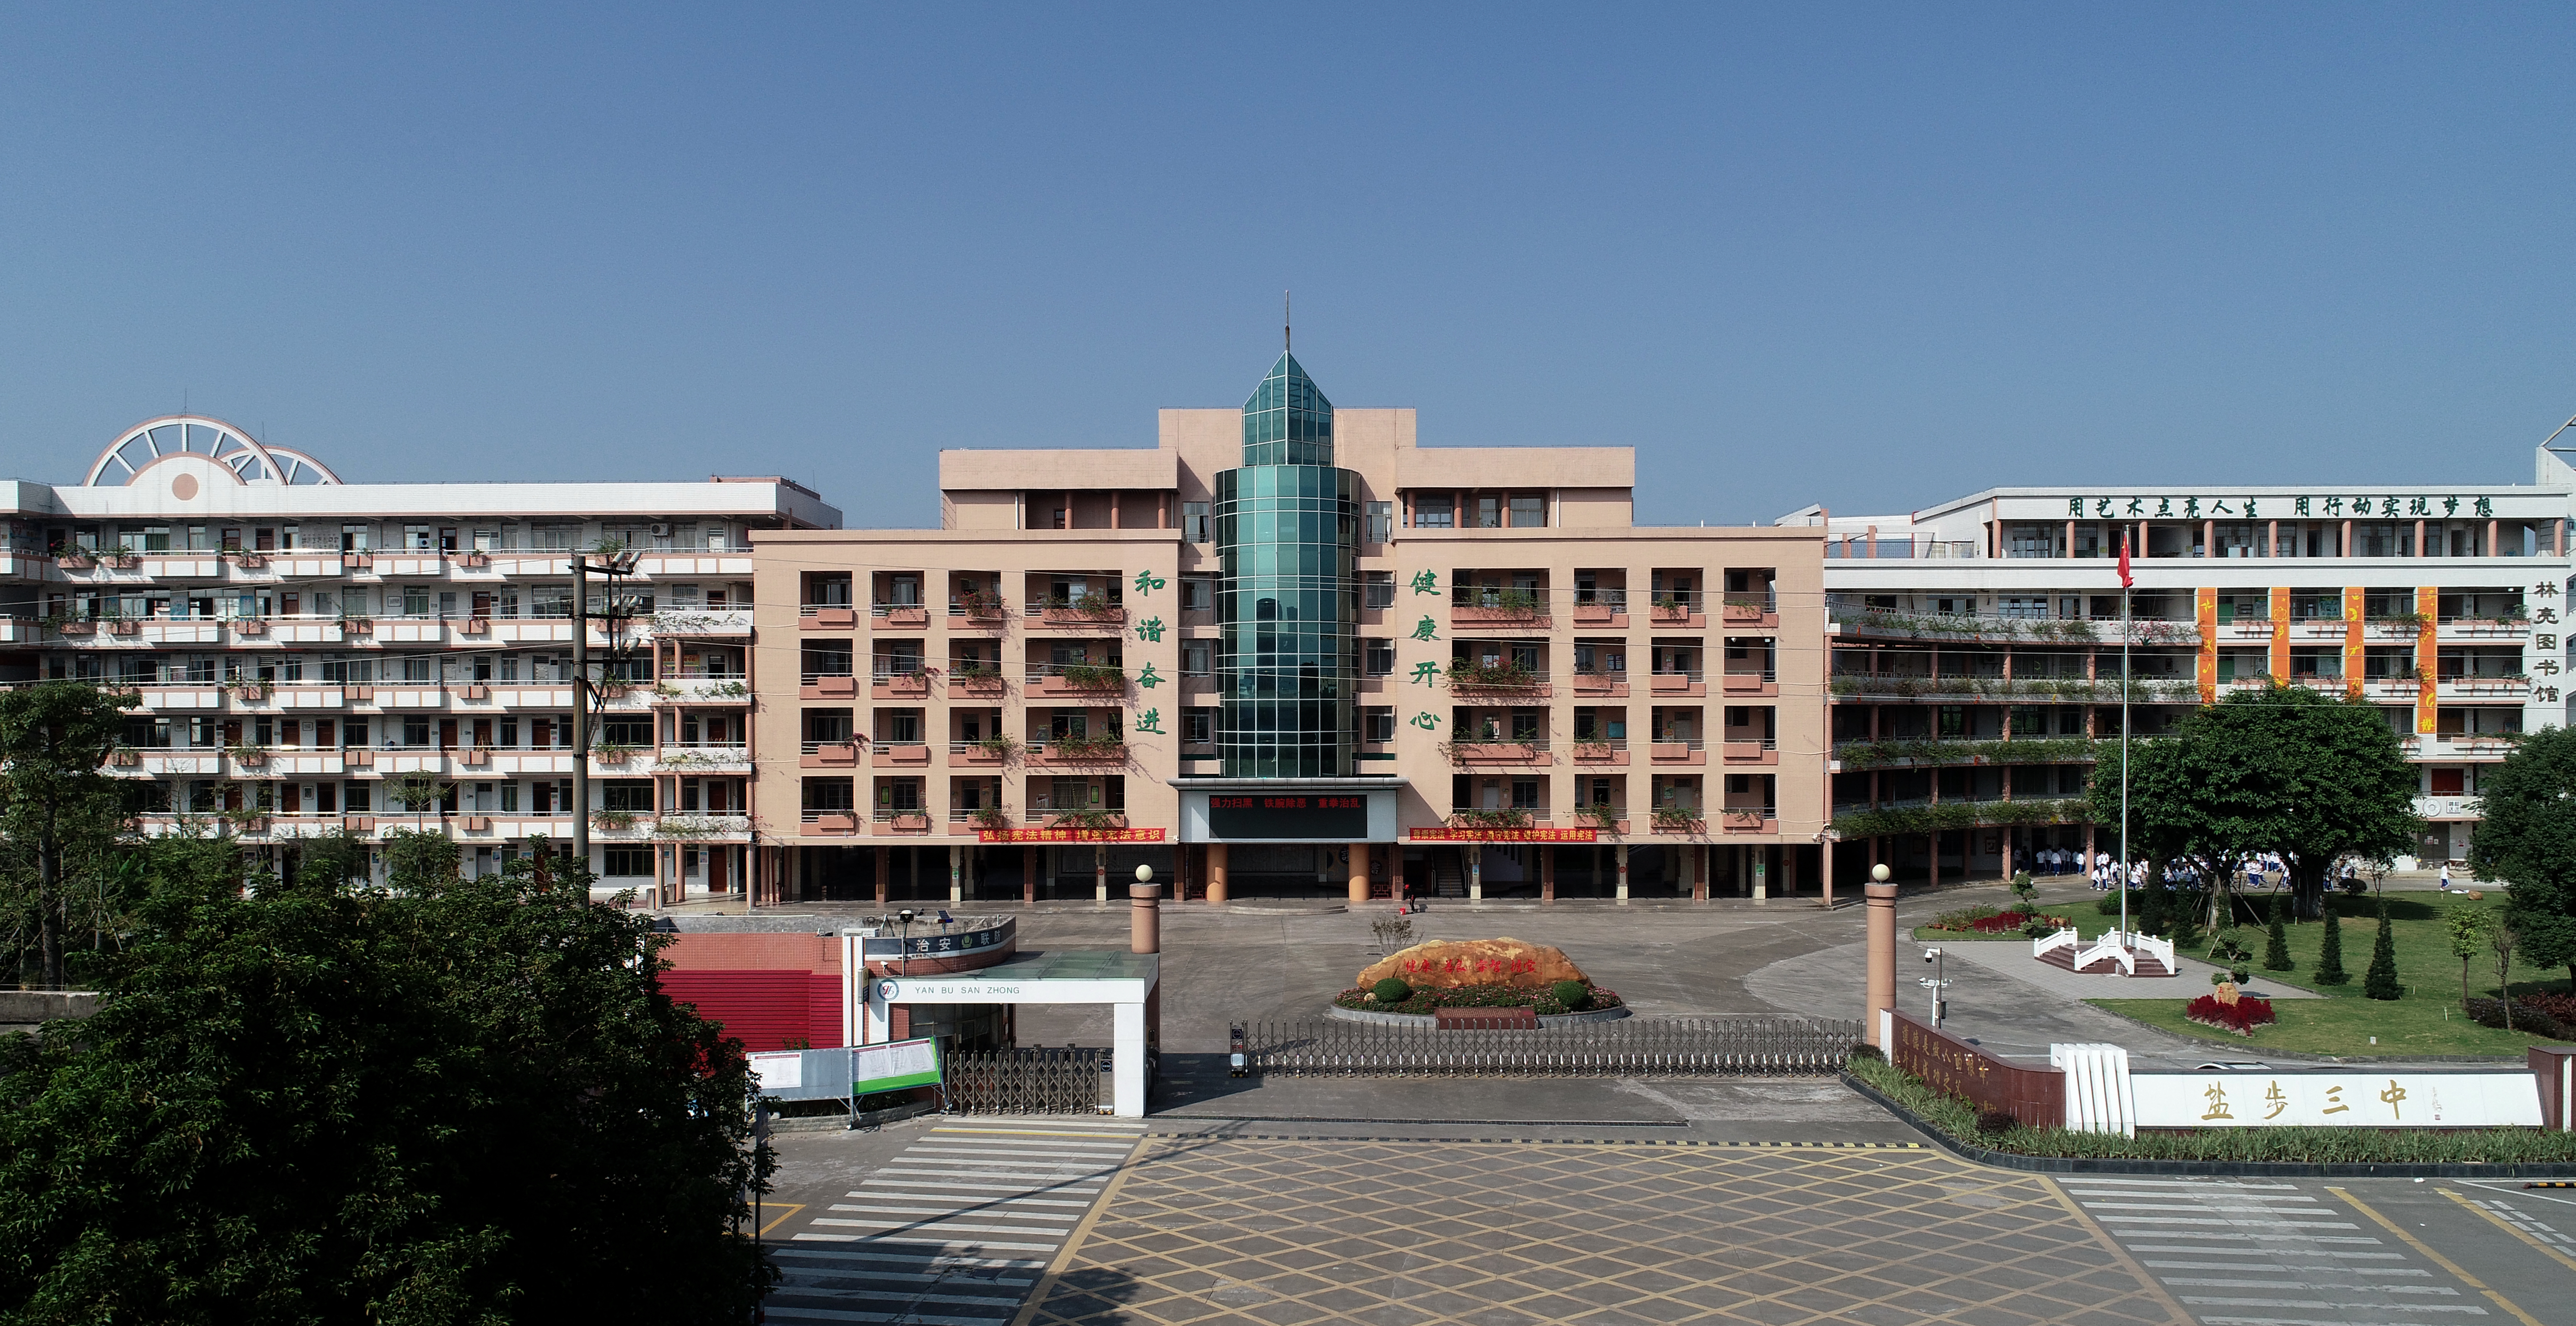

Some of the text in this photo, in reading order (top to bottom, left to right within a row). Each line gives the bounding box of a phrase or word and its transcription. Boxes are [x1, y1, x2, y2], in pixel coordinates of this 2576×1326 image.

[2068, 495, 2493, 518] 用艺术点亮人生 用行动实现梦想
[1134, 569, 1166, 735] 和谐奋进
[1410, 568, 1441, 730] 健康开心
[2533, 581, 2560, 702] 林亮图书馆
[1210, 798, 1360, 808] 强力扫黑 铁腕除恶 重拳治乱
[983, 829, 1161, 840] 弘扬宪法精神 增强宪法意识
[1412, 829, 1593, 841] 尊崇宪法 学习宪法 遵守宪法 维护宪法 运用宪法
[916, 930, 1001, 952] 治安 联防
[1405, 959, 1433, 973] 健康
[1442, 959, 1466, 973] 善良
[2201, 1080, 2407, 1120] 盐步三中
